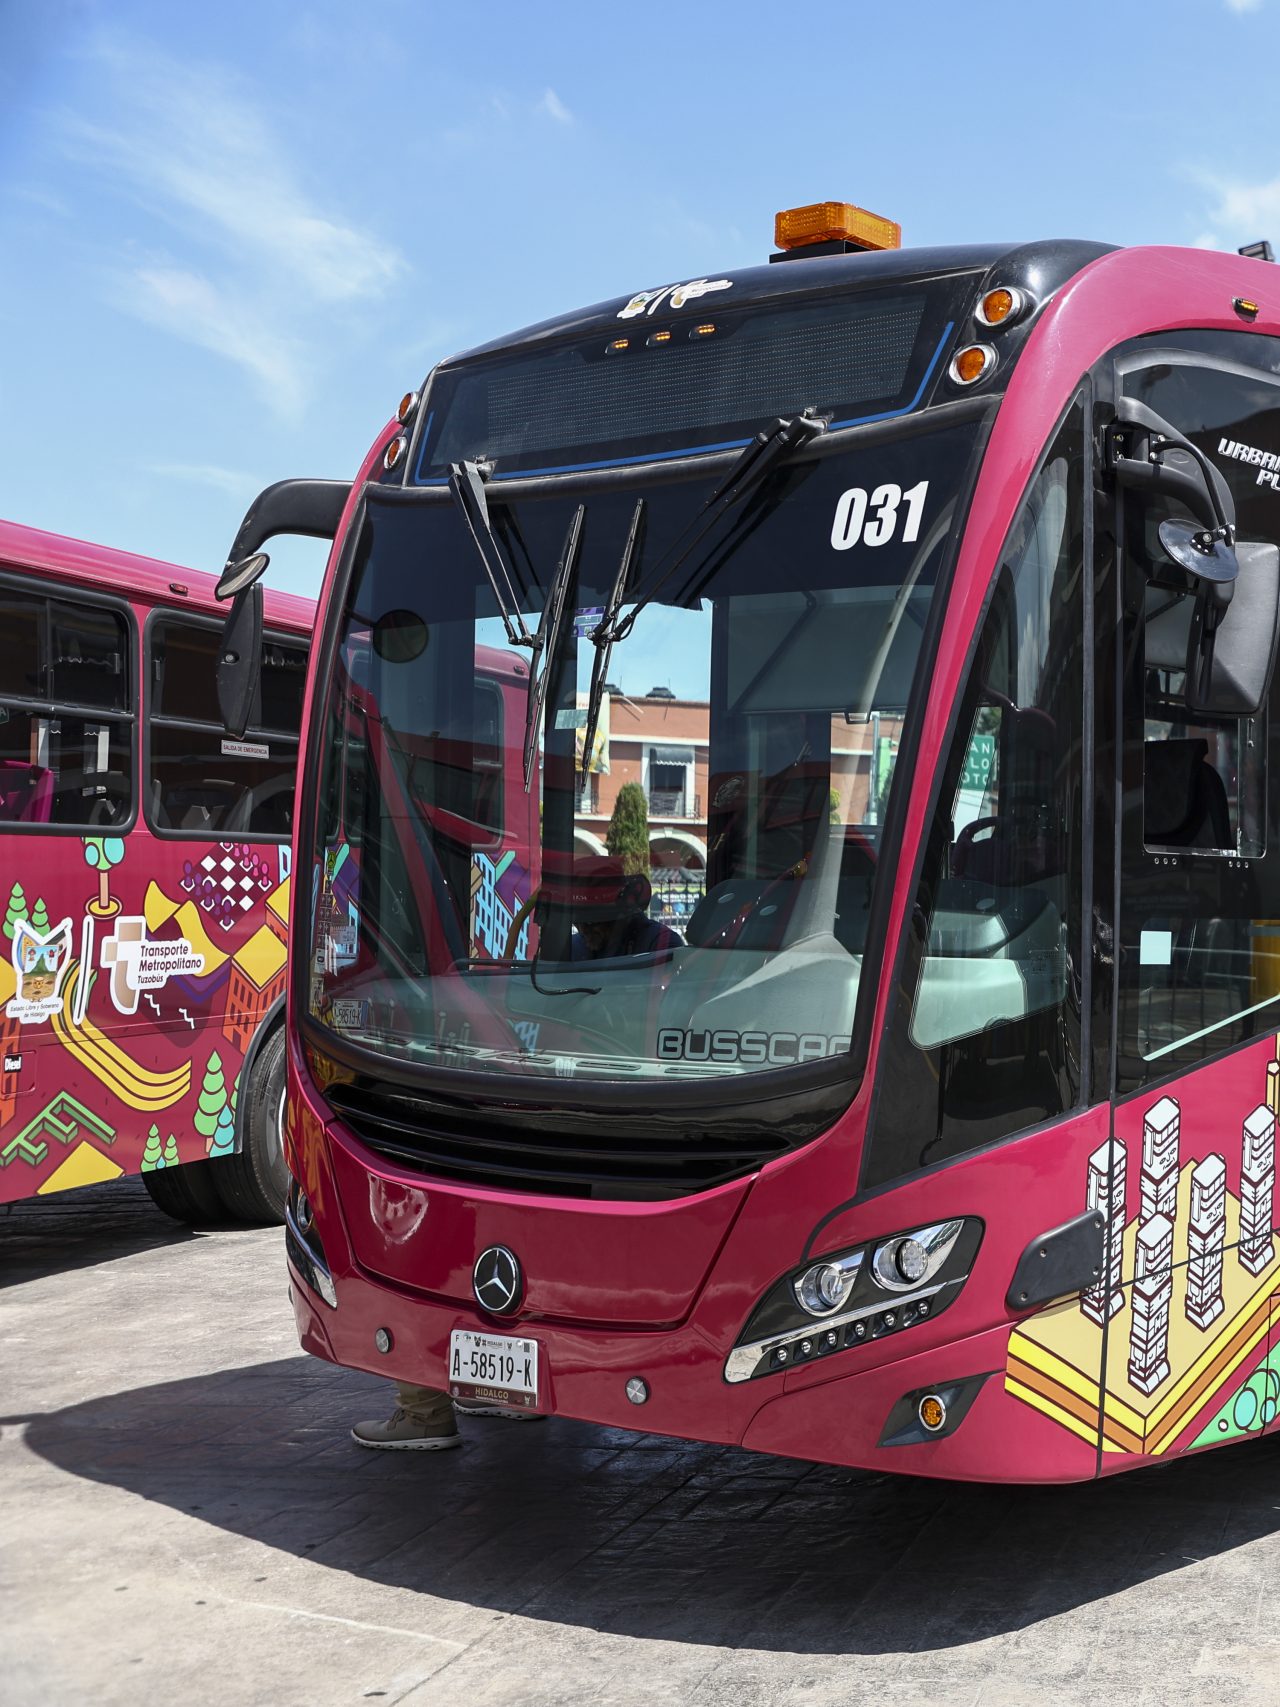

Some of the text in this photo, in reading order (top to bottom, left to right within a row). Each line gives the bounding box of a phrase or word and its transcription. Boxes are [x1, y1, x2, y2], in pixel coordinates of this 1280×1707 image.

[830, 480, 930, 551] 031
[140, 944, 189, 958] Transporte
[138, 958, 202, 974] Metropolitano
[137, 974, 164, 984] Tuzobús
[4, 1056, 22, 1071] Diesel
[452, 1348, 532, 1388] A-58519-K
[475, 1386, 509, 1400] HIDALGO
